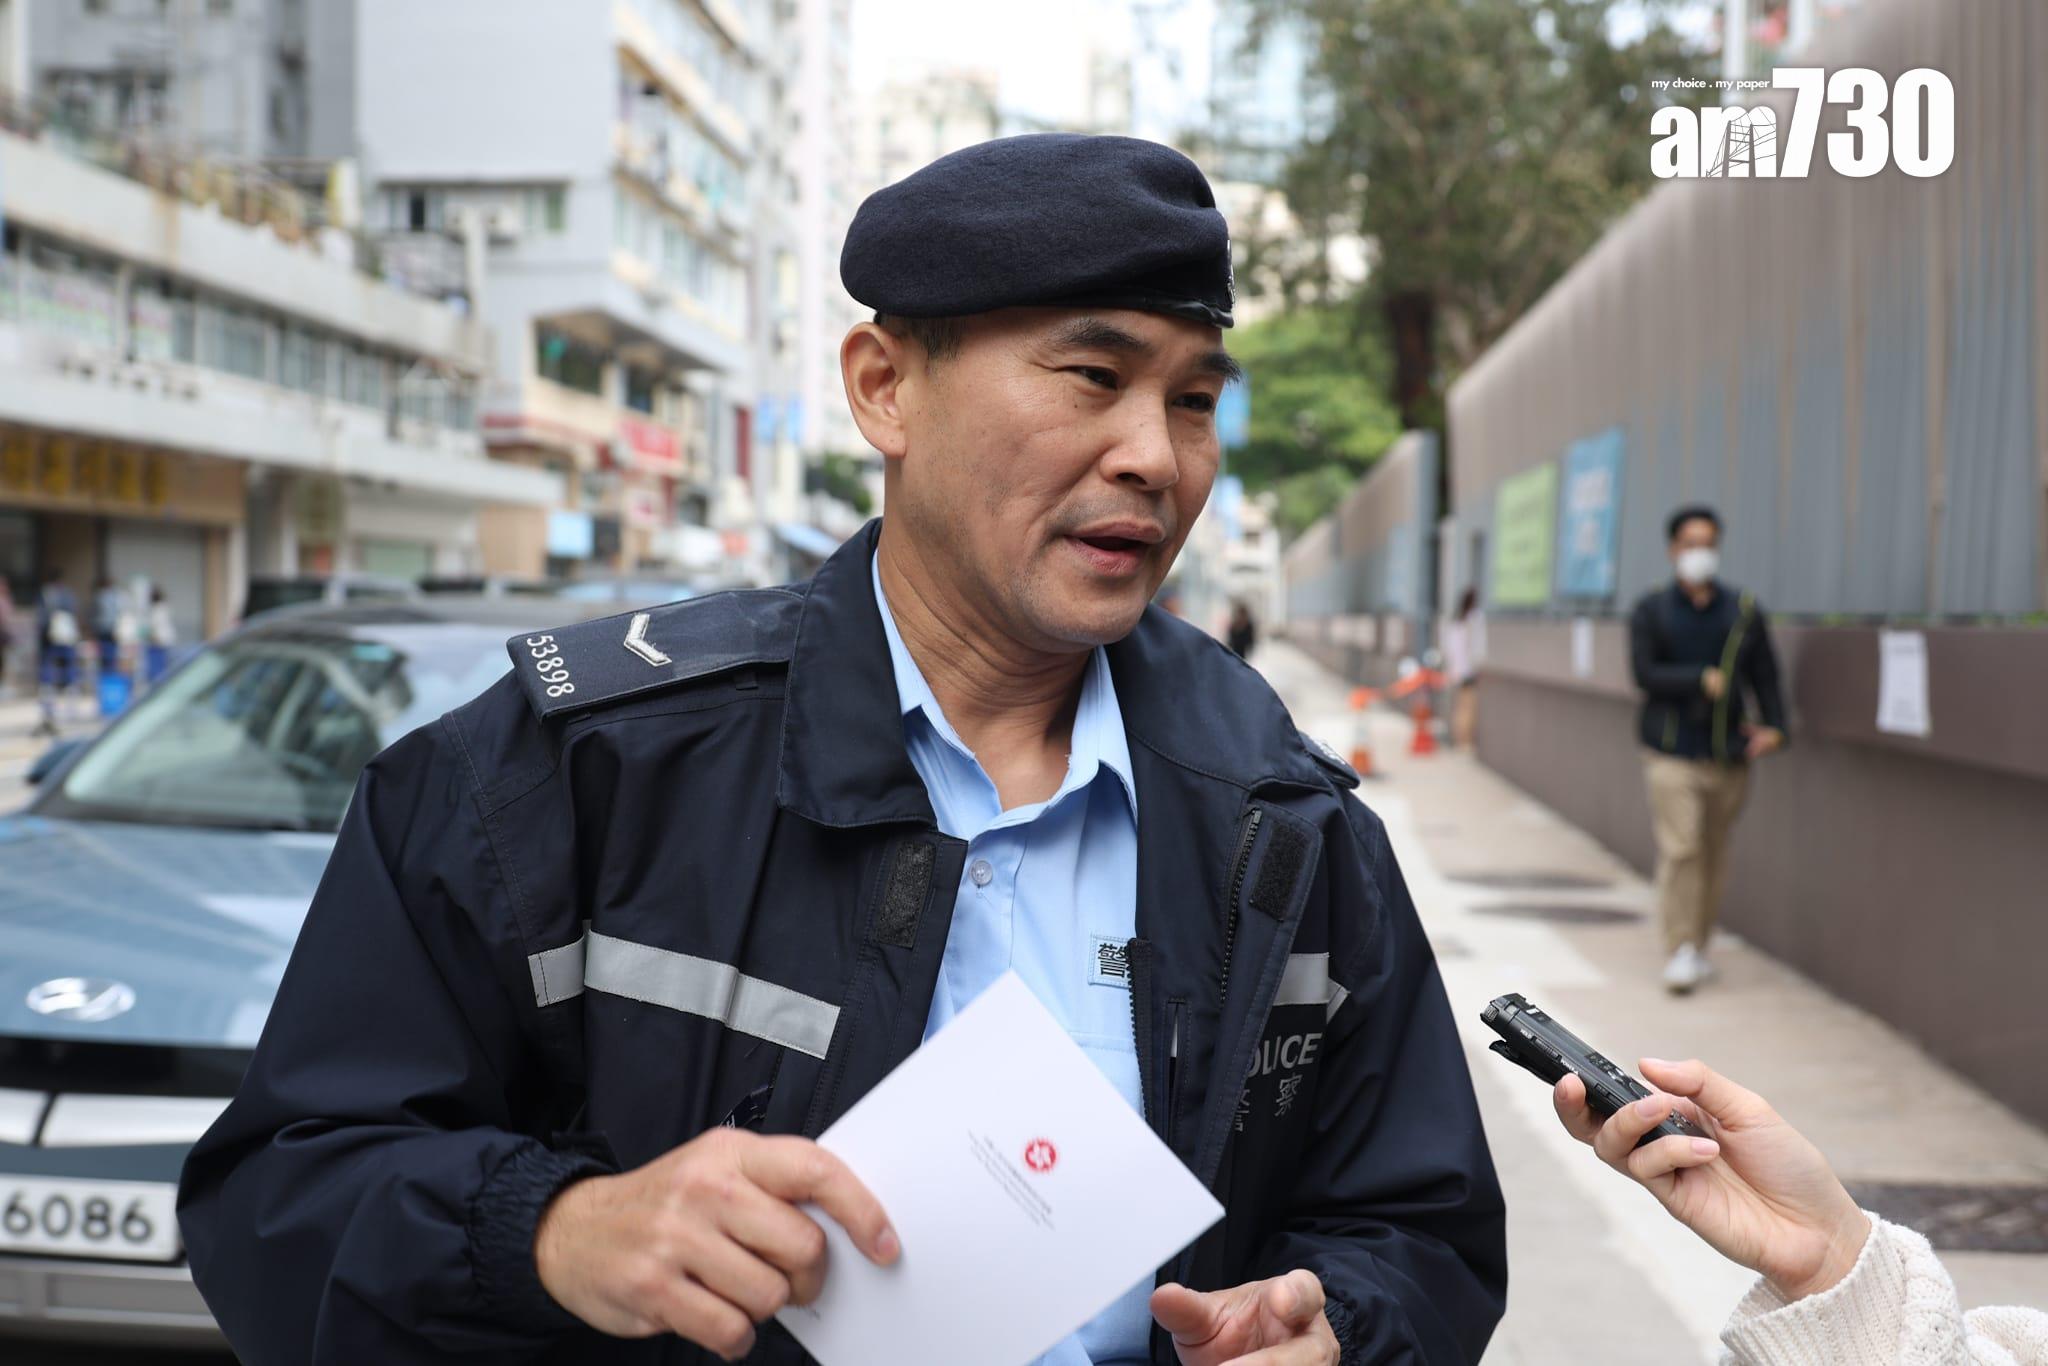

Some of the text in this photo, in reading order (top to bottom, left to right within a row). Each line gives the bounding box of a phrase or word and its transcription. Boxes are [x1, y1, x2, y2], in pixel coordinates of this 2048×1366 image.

[526, 634, 575, 697] 53898
[1247, 1032, 1323, 1078] LICE
[2, 1191, 154, 1244] 6086
